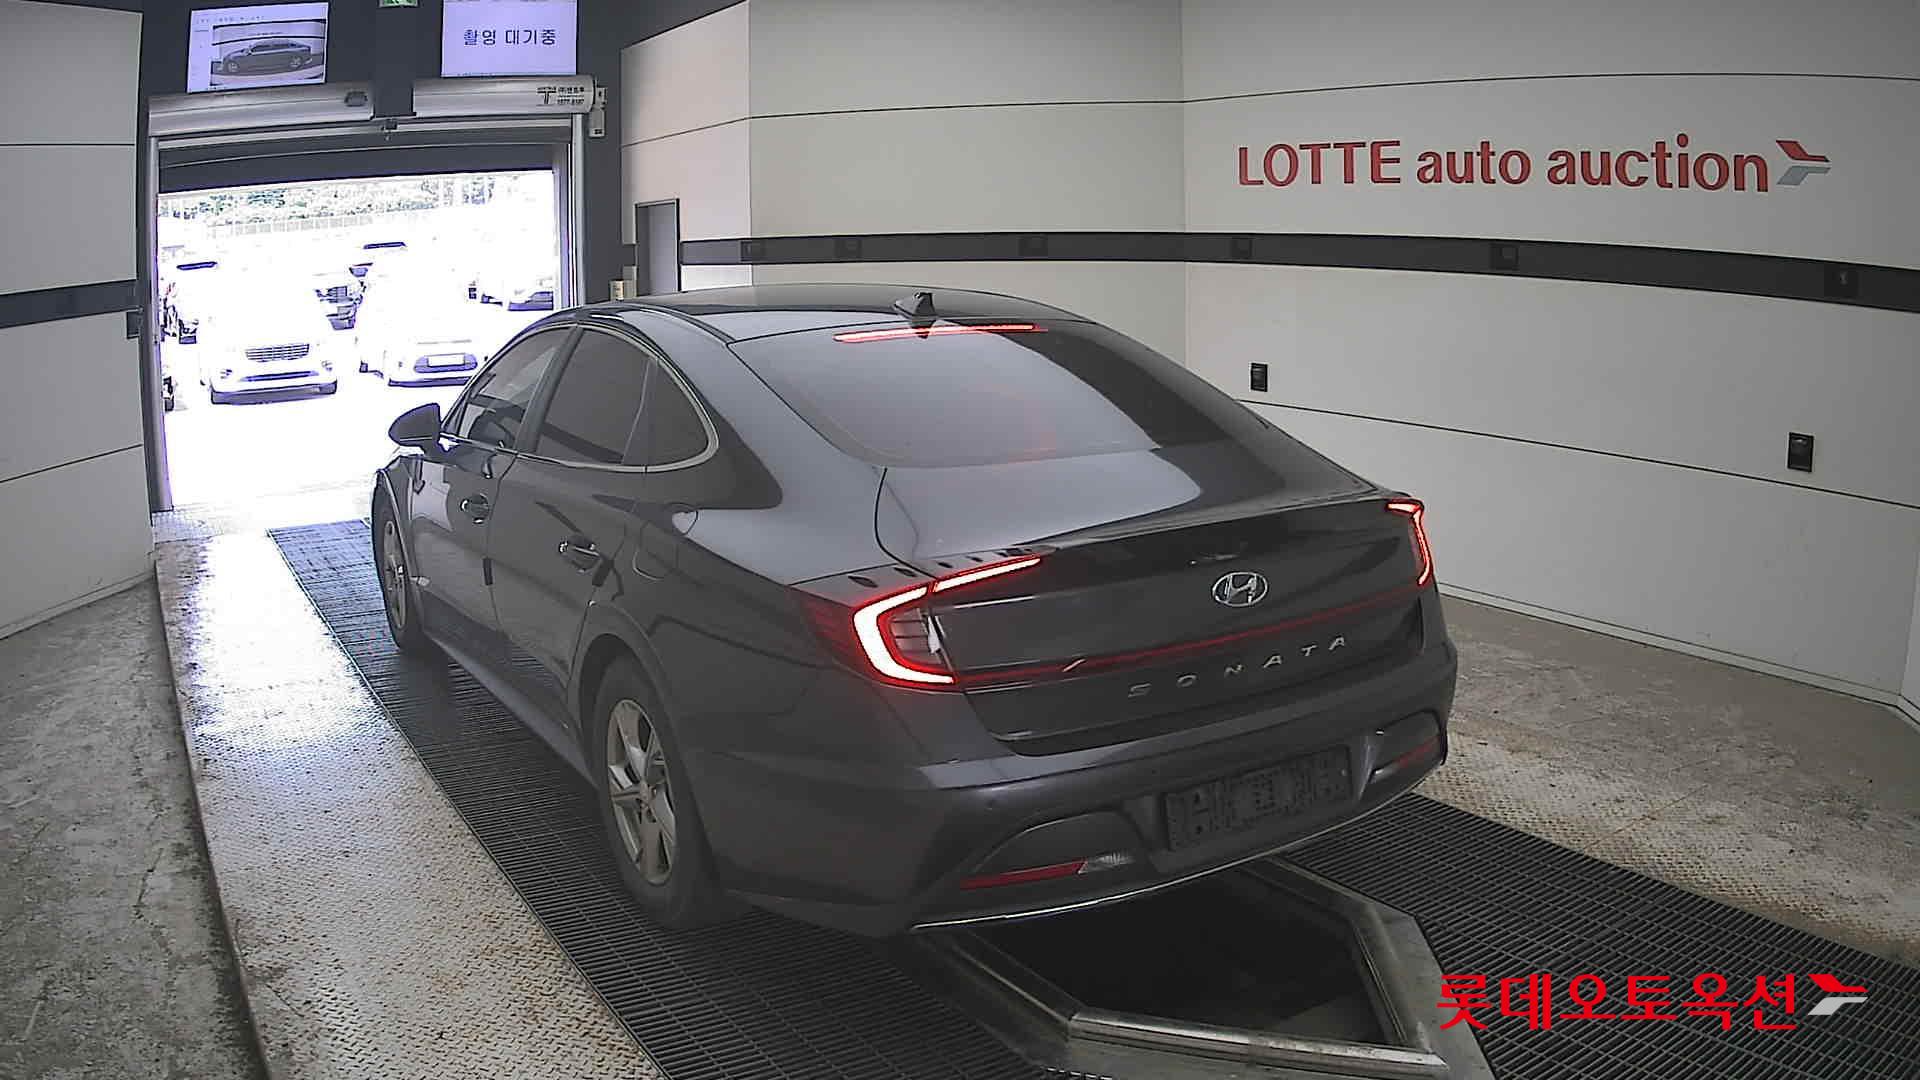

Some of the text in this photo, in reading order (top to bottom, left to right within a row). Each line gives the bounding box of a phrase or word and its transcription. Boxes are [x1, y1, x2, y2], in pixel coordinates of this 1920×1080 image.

[463, 29, 557, 46] 촬영 대기중
[1239, 133, 1769, 193] LOTTE auto auction
[1127, 636, 1346, 699] SONATA
